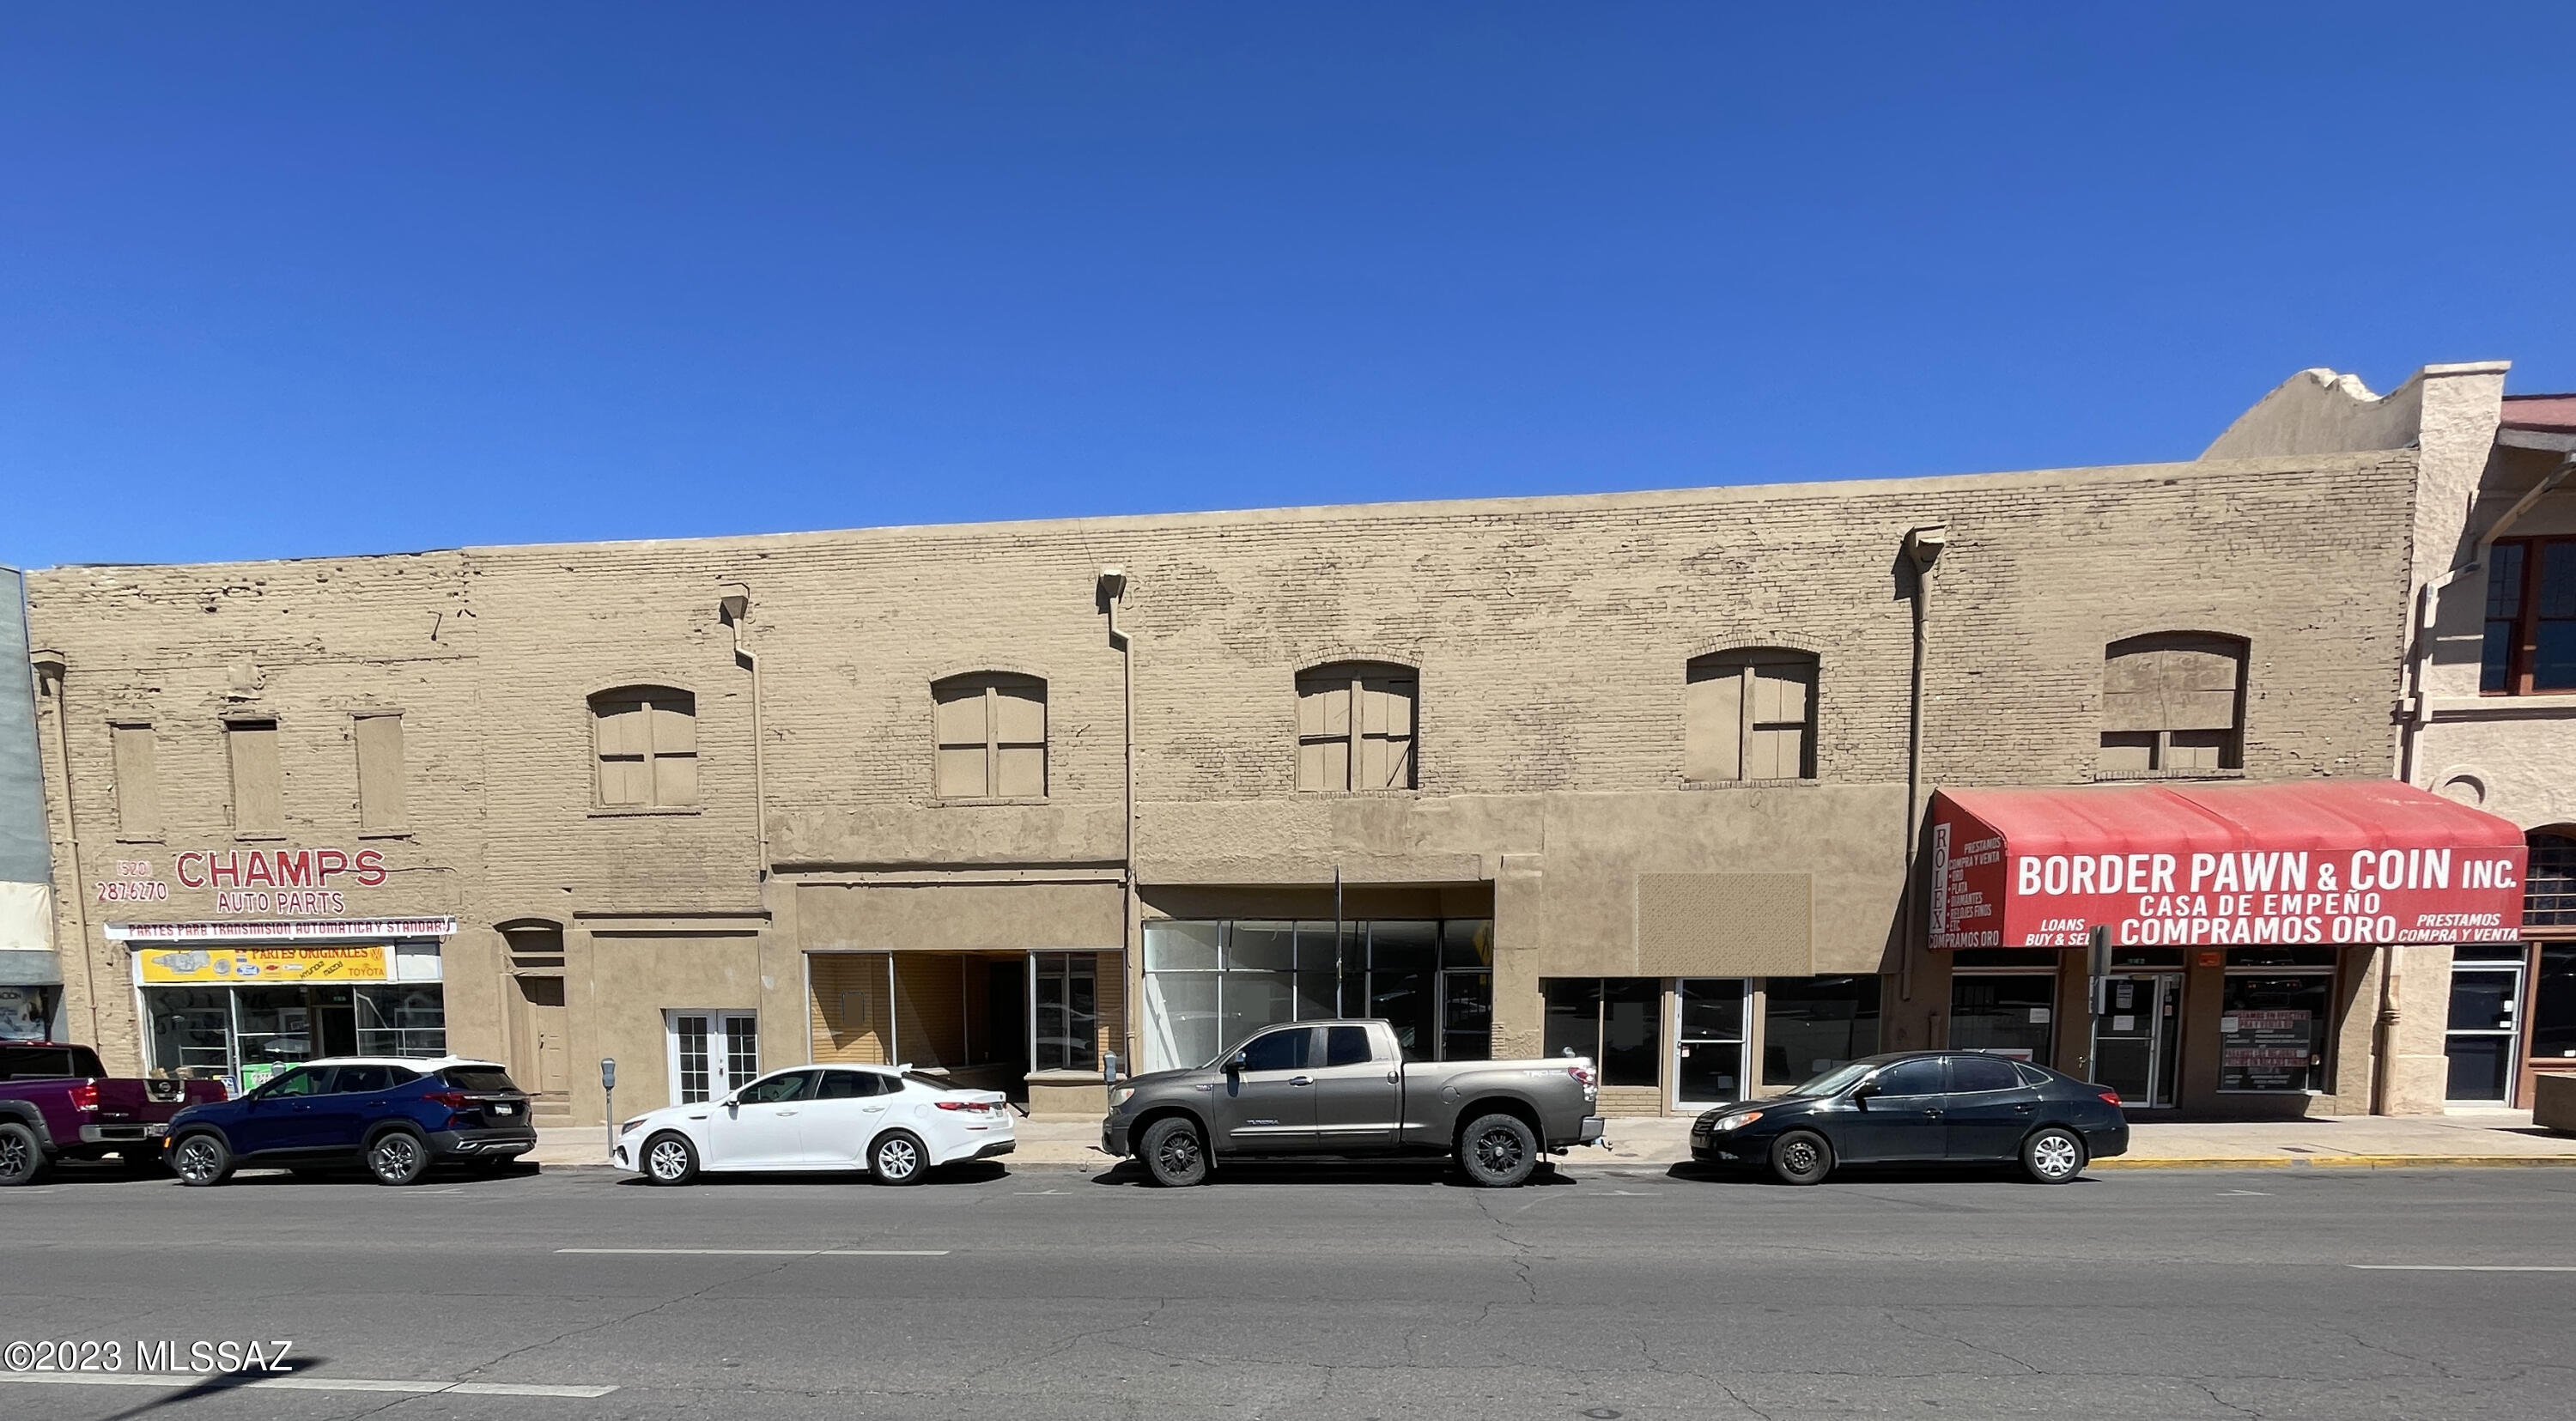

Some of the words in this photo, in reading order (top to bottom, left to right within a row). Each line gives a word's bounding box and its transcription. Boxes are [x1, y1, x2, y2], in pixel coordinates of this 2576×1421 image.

[1965, 837, 2001, 854] PRESTAMOS
[1949, 856, 1973, 870] COMPRA
[1979, 851, 2000, 865] VENTA
[176, 849, 387, 889] CHAMPS
[2018, 853, 2177, 896] BORDER
[2190, 851, 2308, 894] PAWN
[2317, 862, 2339, 891] &
[2350, 848, 2451, 892] COIN
[2462, 859, 2517, 890] INC.
[1933, 828, 1947, 930] ROLEX
[1951, 881, 1968, 895] PLATA
[217, 891, 271, 914] AUTO
[276, 891, 346, 914] PARTS
[1951, 892, 1983, 907] DIAMANTES
[2139, 895, 2208, 917] CASA
[2218, 895, 2253, 916] DE
[2263, 889, 2380, 916] EMPEÑO
[1949, 906, 1974, 920] RELOJES
[1974, 904, 1992, 917] FINOS
[2040, 919, 2085, 932] LOANS
[2416, 914, 2501, 927] PRESTAMOS
[129, 924, 173, 937] PARTES
[211, 921, 291, 936] TRANSMISION
[2121, 916, 2323, 945] COMPRAMOS
[2332, 915, 2397, 944] ORO
[2397, 928, 2457, 942] COMPRA
[2460, 928, 2471, 941] Y
[2474, 927, 2519, 941] VENTA
[1929, 931, 1979, 948] COMPRAMOS
[1981, 930, 1999, 946] ORO
[2025, 933, 2051, 946] BUY
[2054, 933, 2064, 945] &
[2068, 932, 2091, 945] SEL
[252, 948, 296, 959] PARTES
[299, 946, 368, 959] ORIGINALES
[348, 968, 385, 976] TOYOTA
